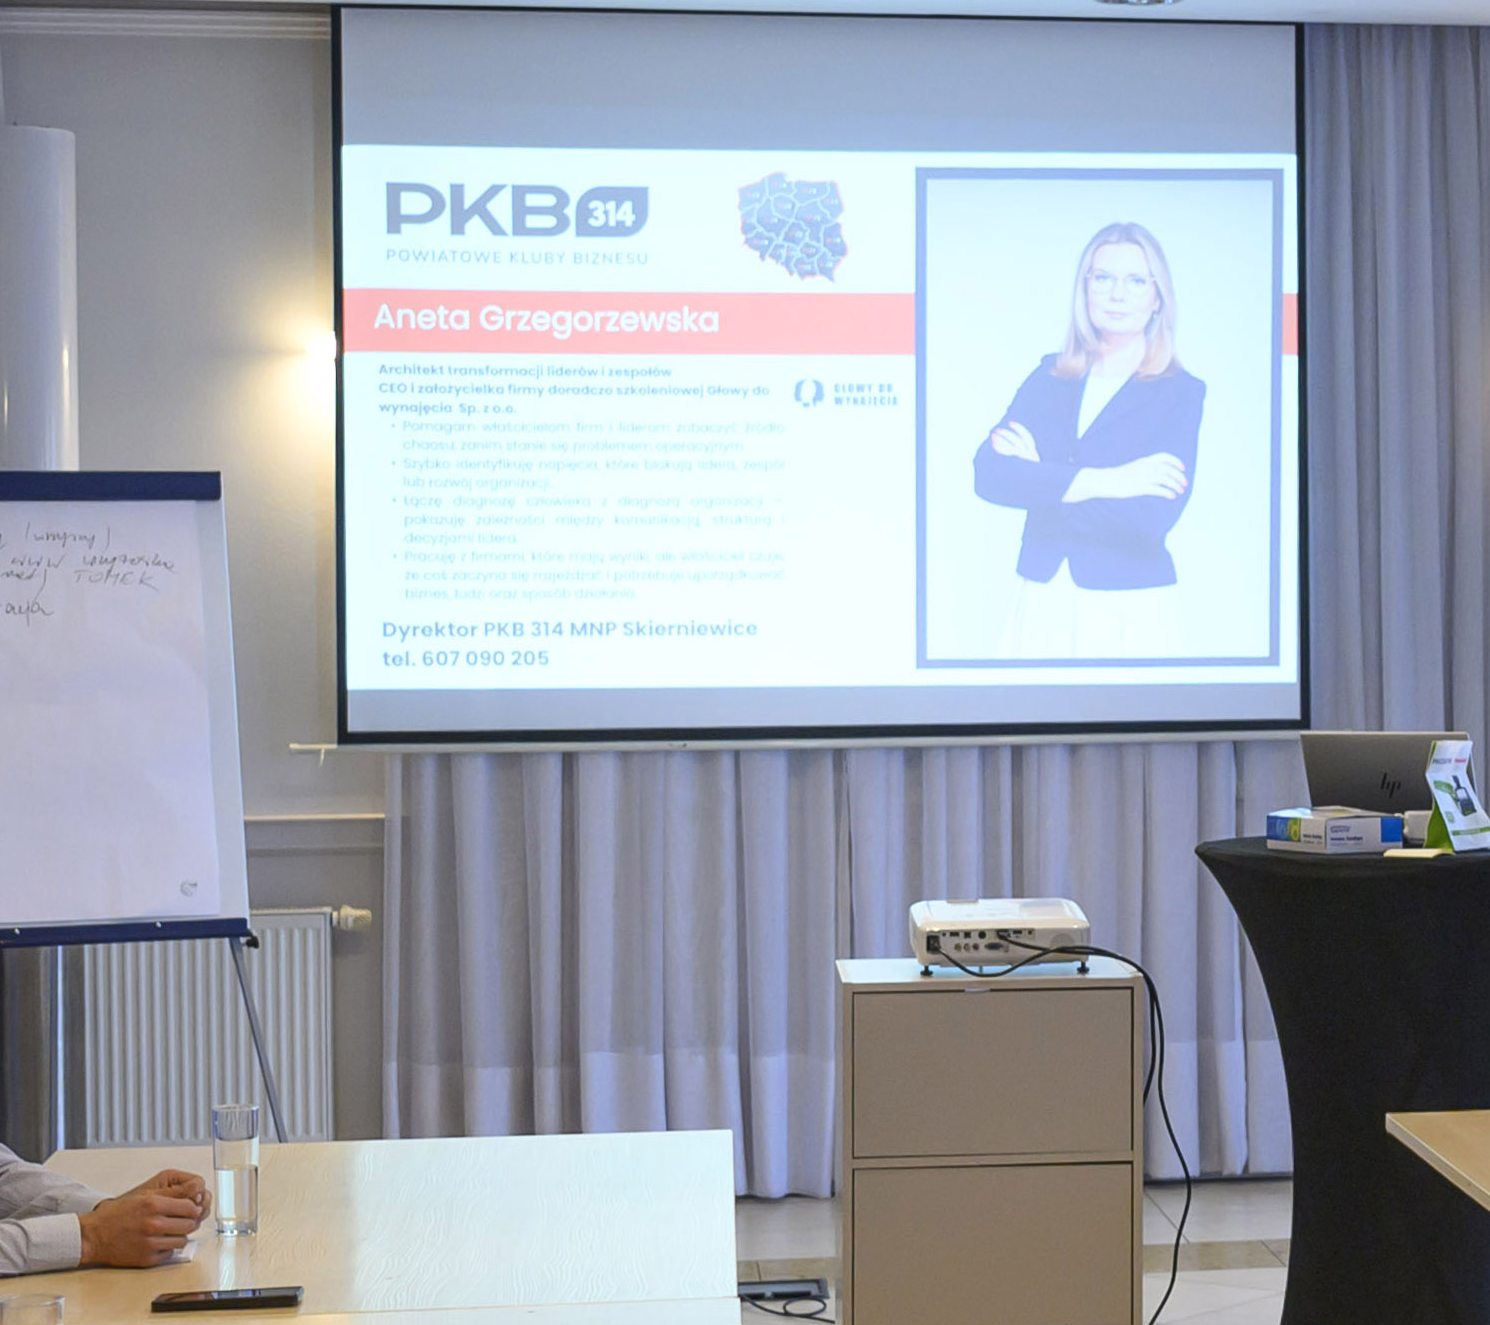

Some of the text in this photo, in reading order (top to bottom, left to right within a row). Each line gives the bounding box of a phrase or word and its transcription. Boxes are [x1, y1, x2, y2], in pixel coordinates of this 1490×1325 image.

[385, 182, 637, 237] PKB 314
[385, 249, 650, 267] POWIATOWE KLUBY BIZNESU
[373, 304, 720, 340] Aneta Grzegorzewska
[378, 363, 444, 376] Architekt
[447, 364, 544, 381] transformacji
[546, 365, 599, 378] liderów
[607, 366, 673, 381] zespołów
[378, 382, 408, 394] CEO
[417, 382, 505, 398] założycielka
[507, 383, 545, 399] firmy
[547, 384, 614, 397] doradczo
[615, 383, 705, 400] szkoleniowej
[706, 384, 750, 400] Głowy
[751, 385, 771, 397] do
[378, 401, 453, 417] wynajęcia
[458, 402, 480, 417] Sp.
[382, 619, 758, 642] Dyrektor PKB 314 MNP Skierniewice
[382, 649, 550, 667] tel. 607 090 205
